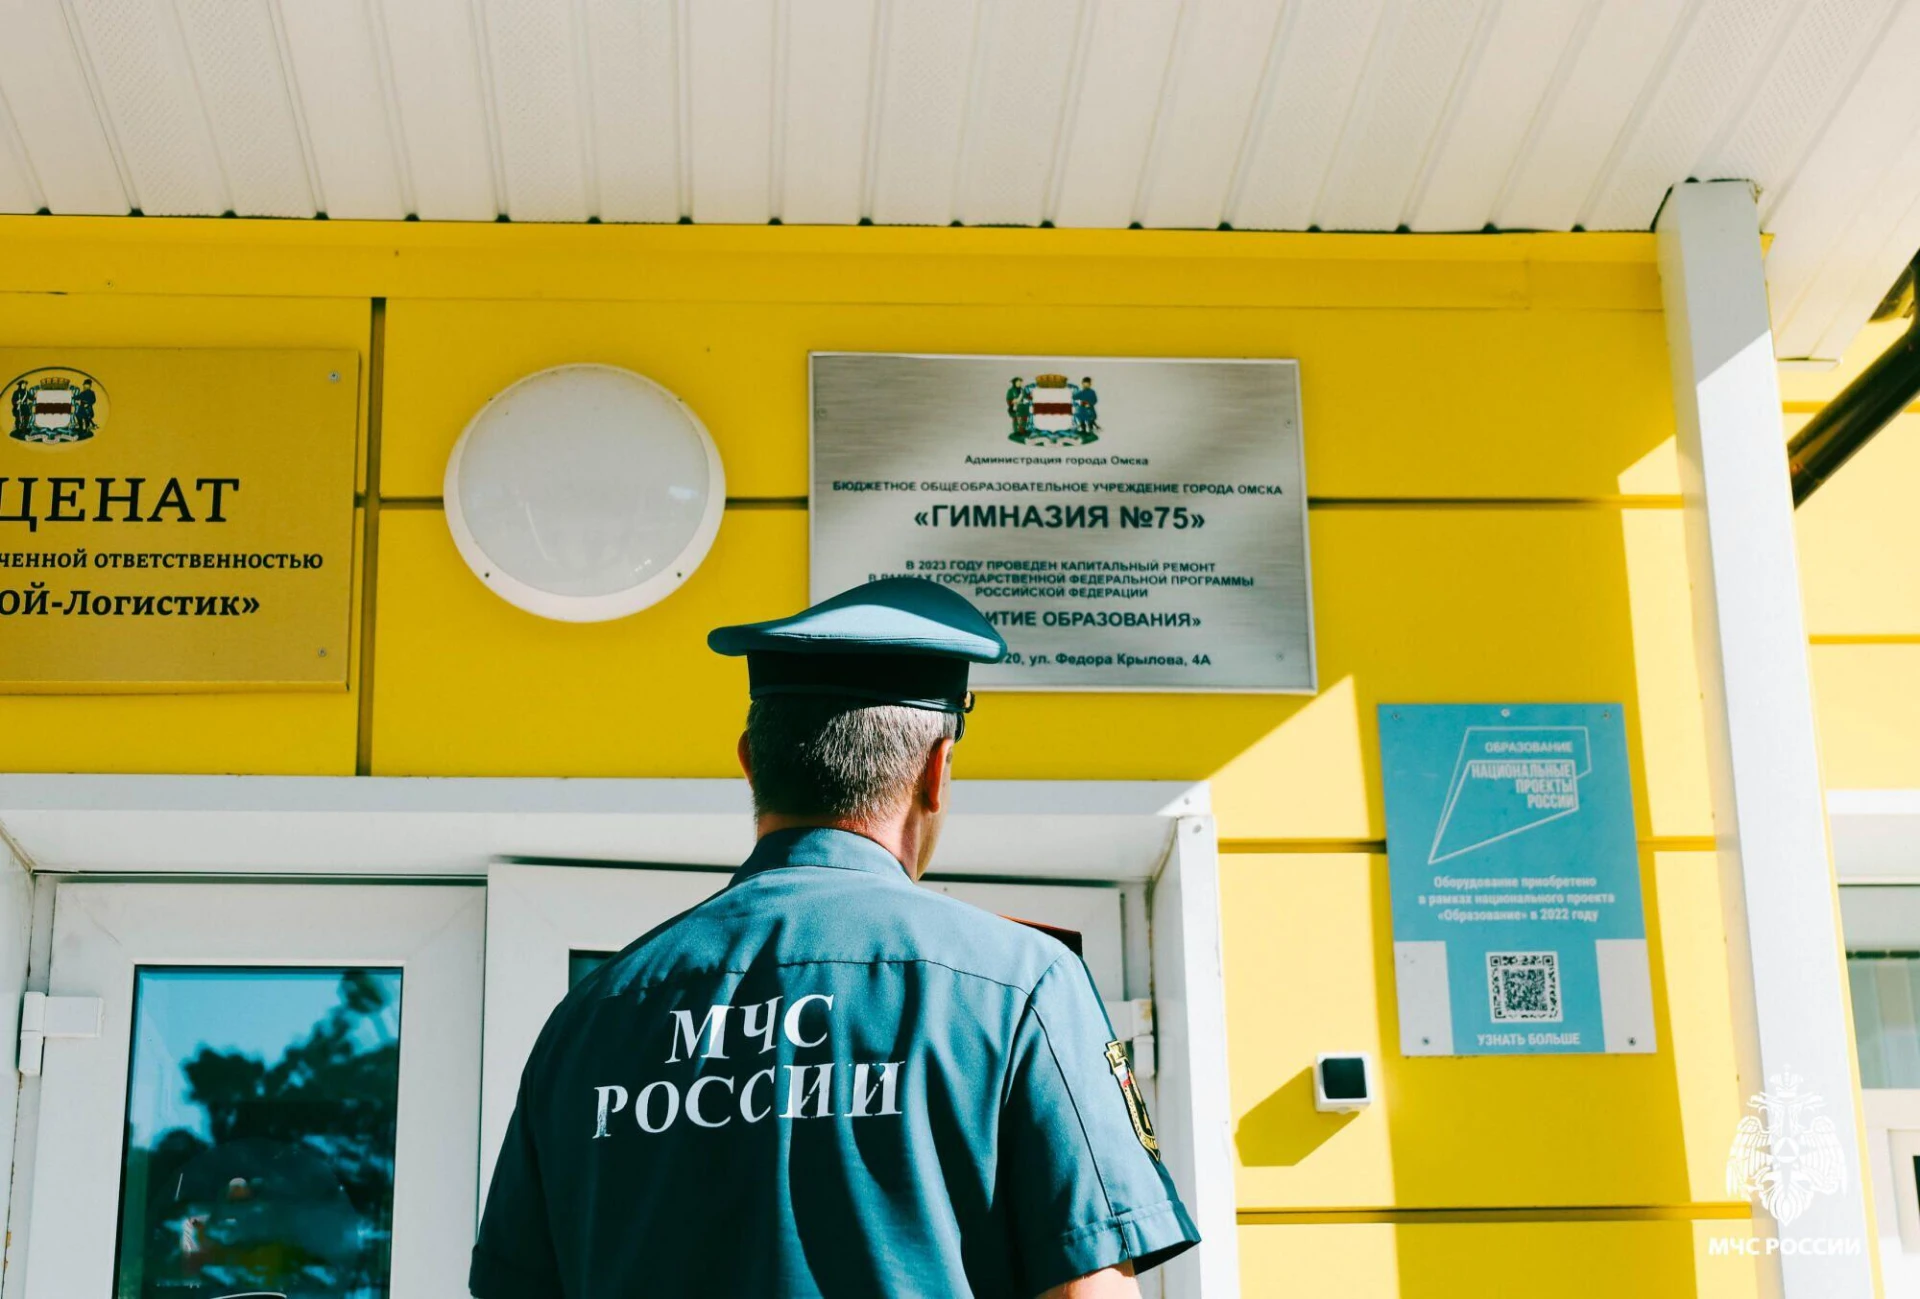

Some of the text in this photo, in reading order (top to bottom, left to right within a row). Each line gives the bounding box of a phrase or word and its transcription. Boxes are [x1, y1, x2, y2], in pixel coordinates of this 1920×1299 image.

[964, 455, 1149, 467] Администрация города Омска
[833, 480, 1283, 495] БЮДЖЕТНОЕ ОБЩЕОБРАЗОВАТЕЛЬНОЕ УЧРЕЖДЕНИЕ ГОРОДА ОМСКА
[0, 476, 239, 532] ЦЕНАТ
[914, 505, 1205, 529] «ГИМНАЗИЯ №75»
[0, 548, 323, 569] ЧЕННОЙ ОТВЕТСТВЕННОСТЬЮ
[906, 560, 1215, 572] В 2023 ГОДУ ПРОВЕДЕН КАПИТАЛЬНЫЙ РЕМОНТ
[936, 572, 1066, 585] ГОСУДАРСТВЕННОЙ
[1069, 574, 1167, 586] ФЕДЕРАЛЬНОЙ
[1171, 576, 1254, 587] ПРОГРАММЫ
[0, 582, 260, 616] ОЙ-Логистик»
[975, 585, 1148, 599] РОССИЙСКОЙ ФЕДЕРАЦИИ
[982, 611, 1201, 627] ИТИЕ ОБРАЗОВАНИЯ»
[1000, 653, 1211, 668] 20, ул. Федора Крылова, 4А
[1485, 741, 1573, 753] ОБРАЗОВАНИЕ
[1471, 763, 1571, 780] НАЦИОНАЛЬНЫЕ
[1516, 778, 1573, 793] ПРОЕКТЫ
[1527, 794, 1576, 809] РОССИИ
[1434, 875, 1597, 889] Оборудование приобретено
[1418, 893, 1615, 906] в рамках национального проекта
[1438, 908, 1599, 922] «Образование» в 2022 году
[664, 994, 835, 1063] МЧС
[1477, 1032, 1581, 1046] УЗНАТЬ БОЛЬШЕ
[592, 1060, 906, 1140] РОССИИ
